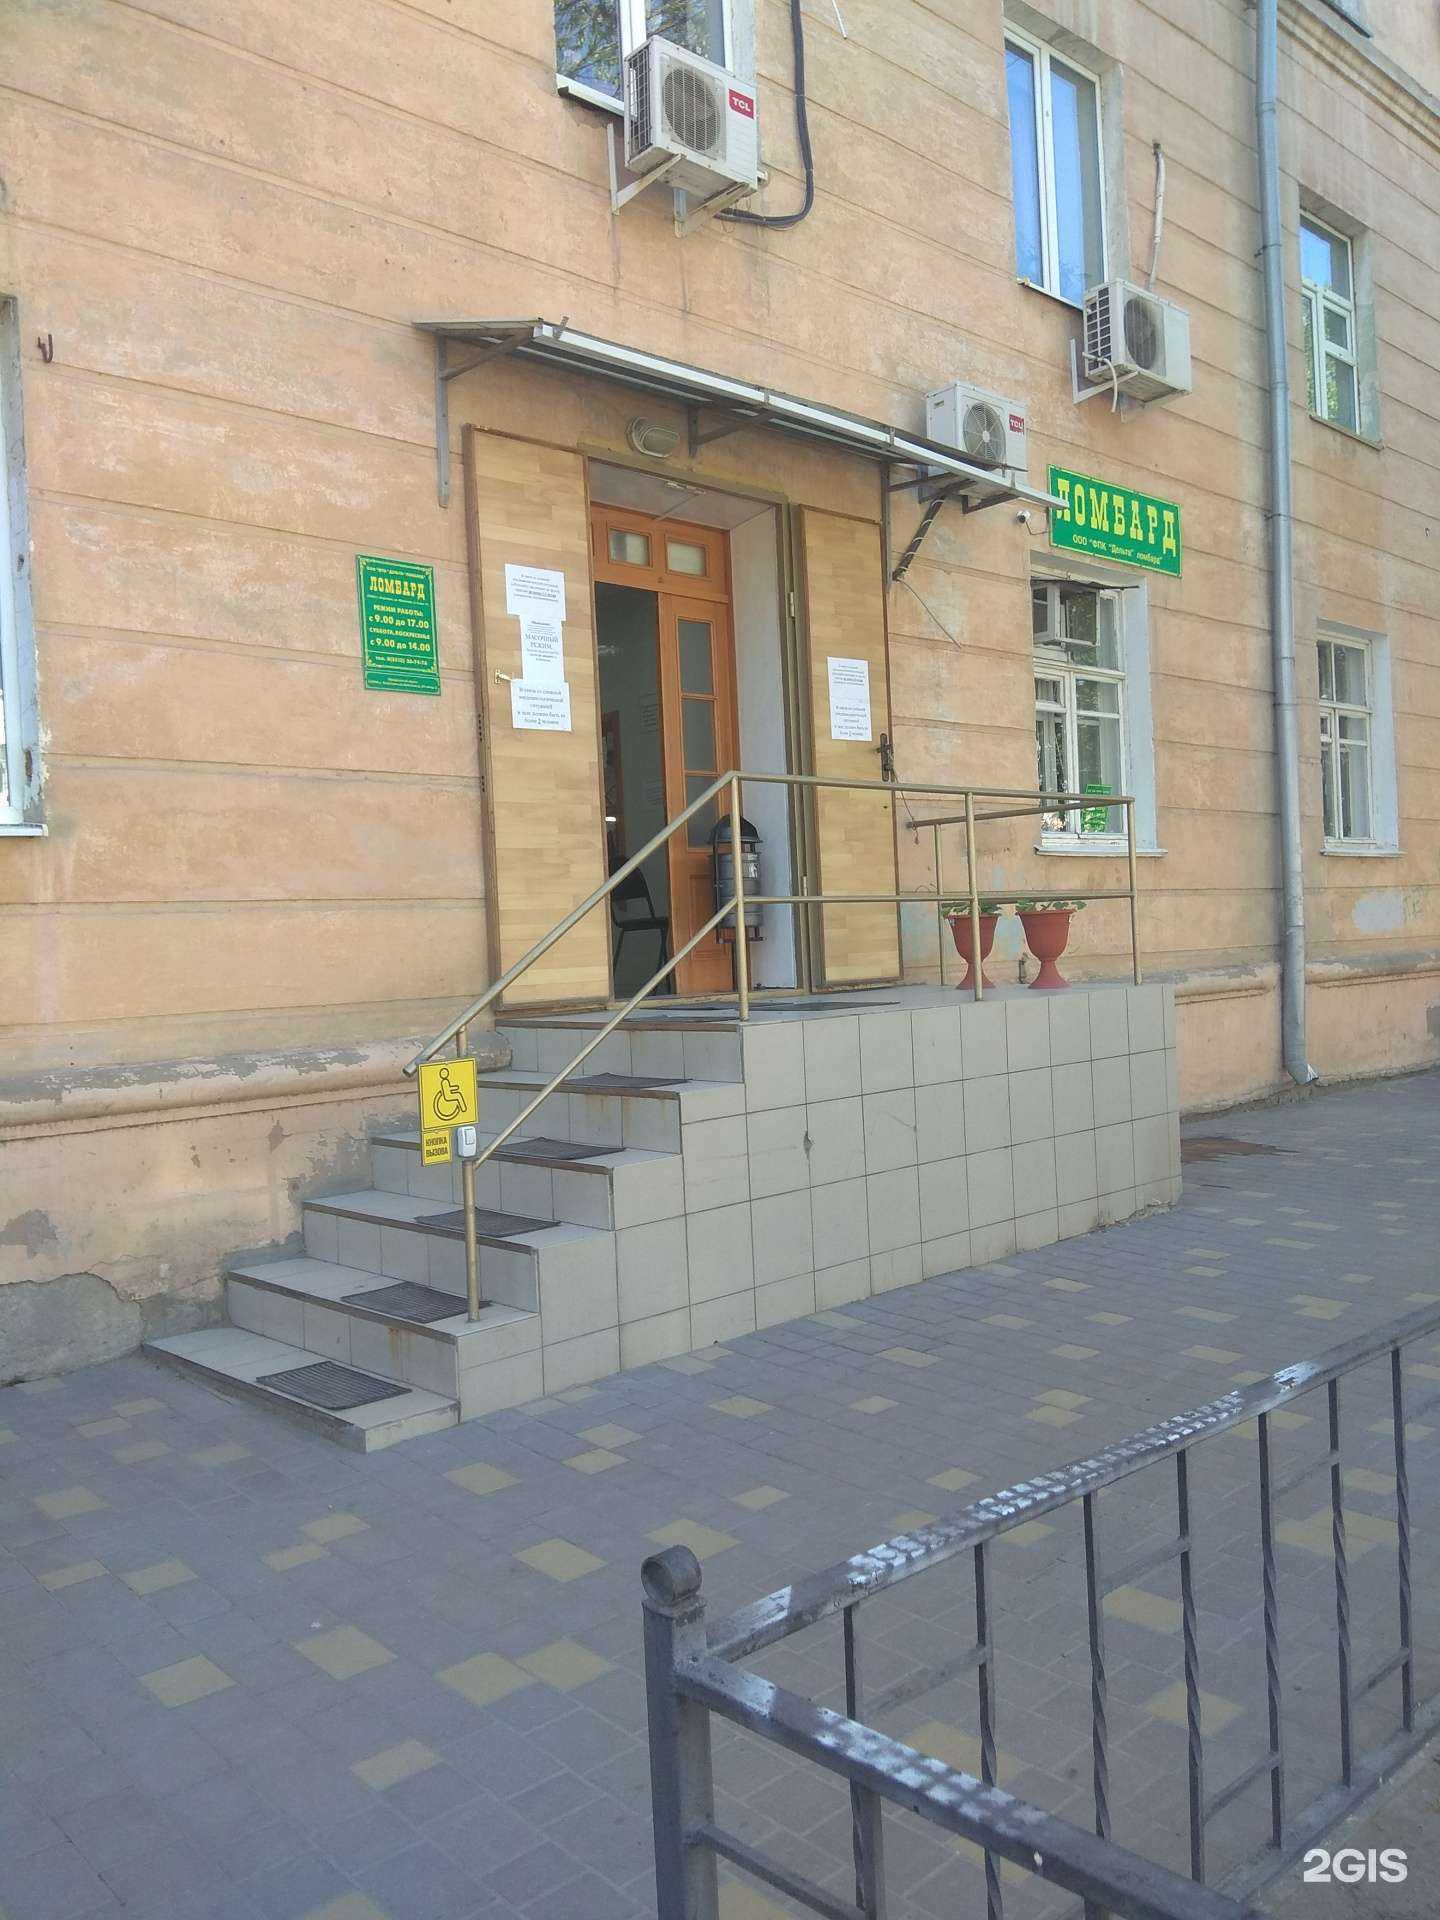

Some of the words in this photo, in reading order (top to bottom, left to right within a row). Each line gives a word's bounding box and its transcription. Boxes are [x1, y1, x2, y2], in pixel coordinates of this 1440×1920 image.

[732, 97, 751, 111] TCL
[1056, 478, 1176, 557] ЛОМБАРД
[1072, 534, 1088, 546] ООО
[369, 576, 426, 601] ЛОМБАРД
[373, 604, 396, 613] РЕЖИМ
[374, 614, 394, 625] 9.00
[395, 619, 405, 627] до
[406, 618, 429, 629] 17.00
[375, 637, 395, 647] 9.00
[396, 642, 407, 650] до
[408, 641, 431, 652] 14.00
[425, 1136, 448, 1147] КНОПКА
[425, 1147, 448, 1158] ВЫЗОВА
